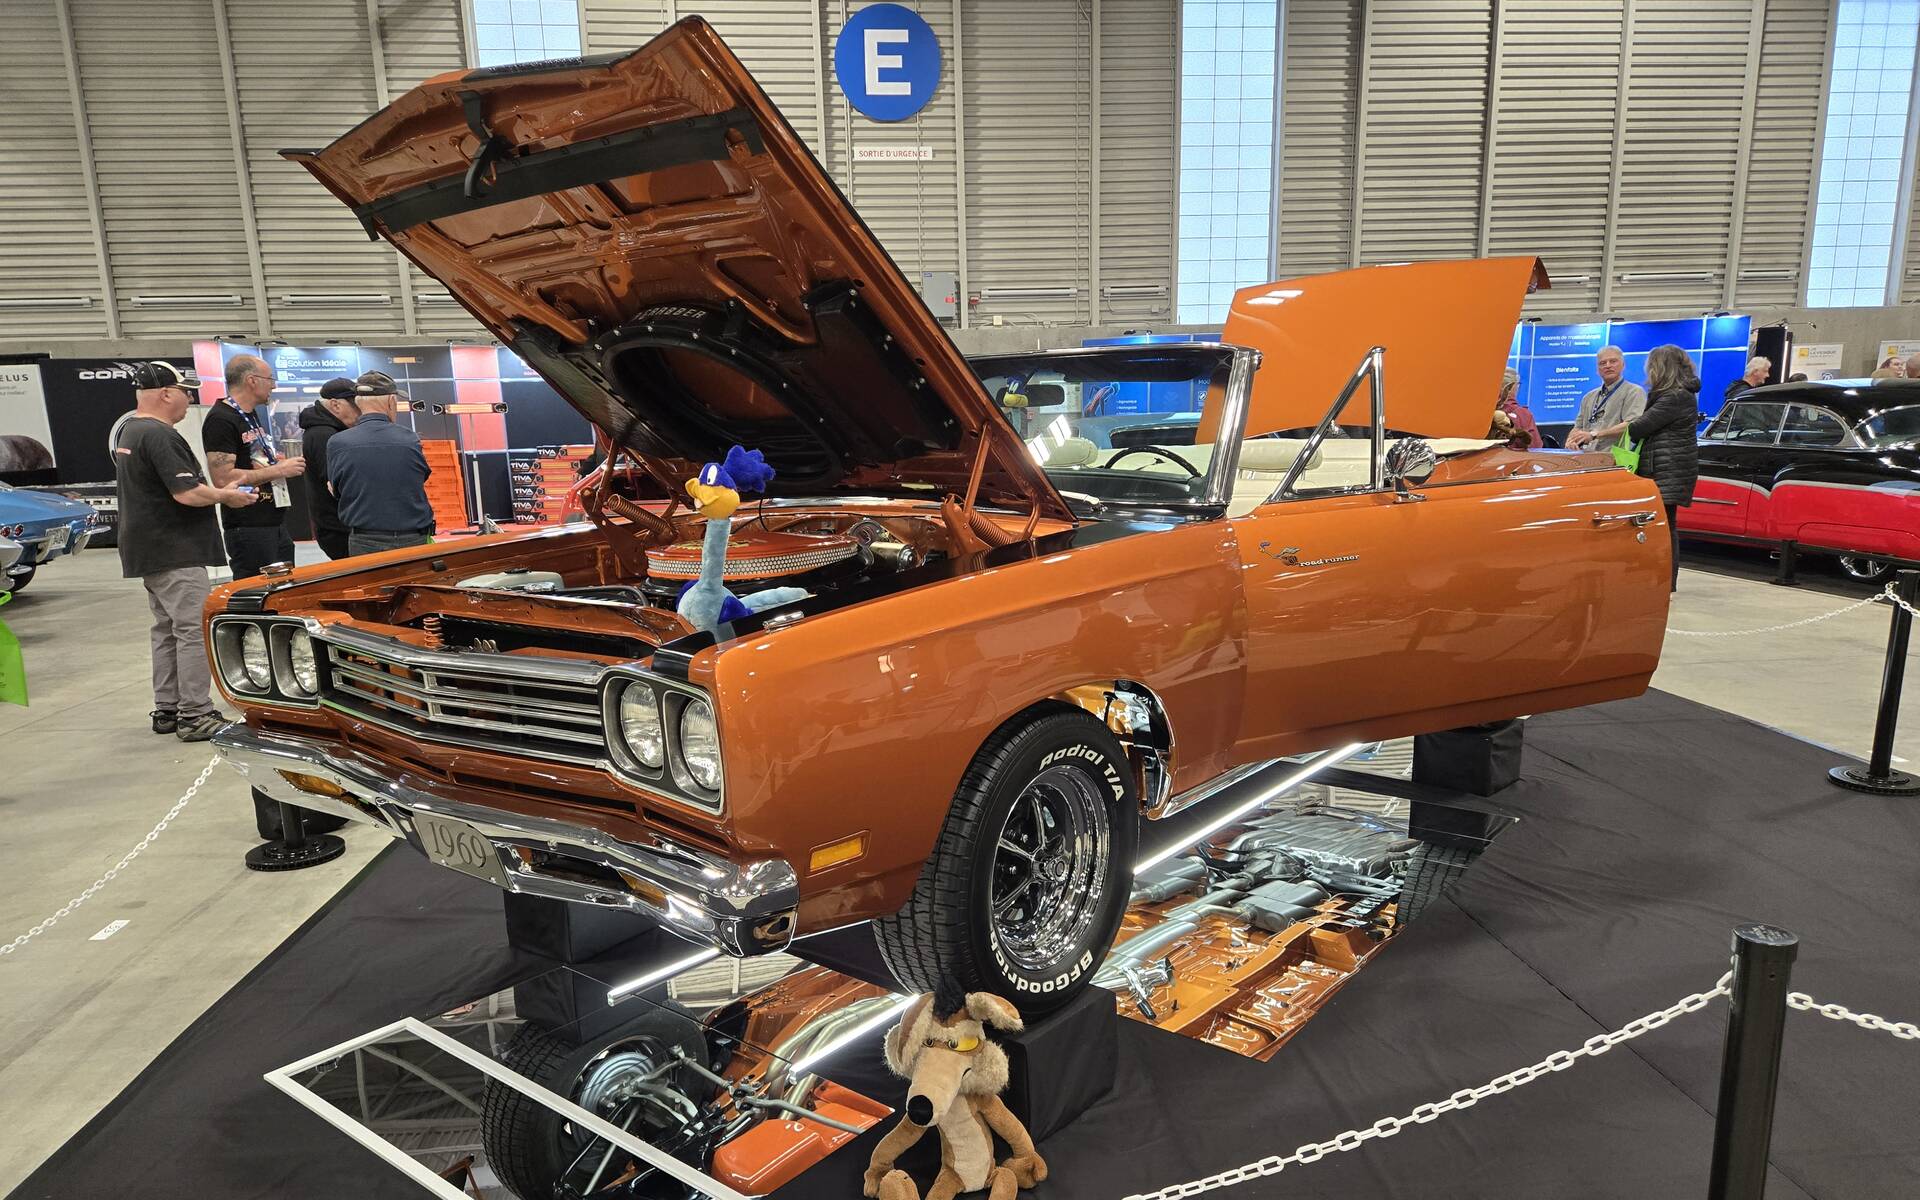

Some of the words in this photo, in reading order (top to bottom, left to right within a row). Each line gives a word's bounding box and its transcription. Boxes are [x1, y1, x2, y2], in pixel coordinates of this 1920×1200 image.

[864, 29, 912, 96] E
[858, 150, 884, 158] SORTIE
[886, 150, 928, 158] D'URGENCE
[1038, 744, 1105, 771] Radial
[1104, 763, 1126, 802] T/A
[427, 821, 487, 868] 1969
[989, 930, 1094, 994] BFGoodrich
